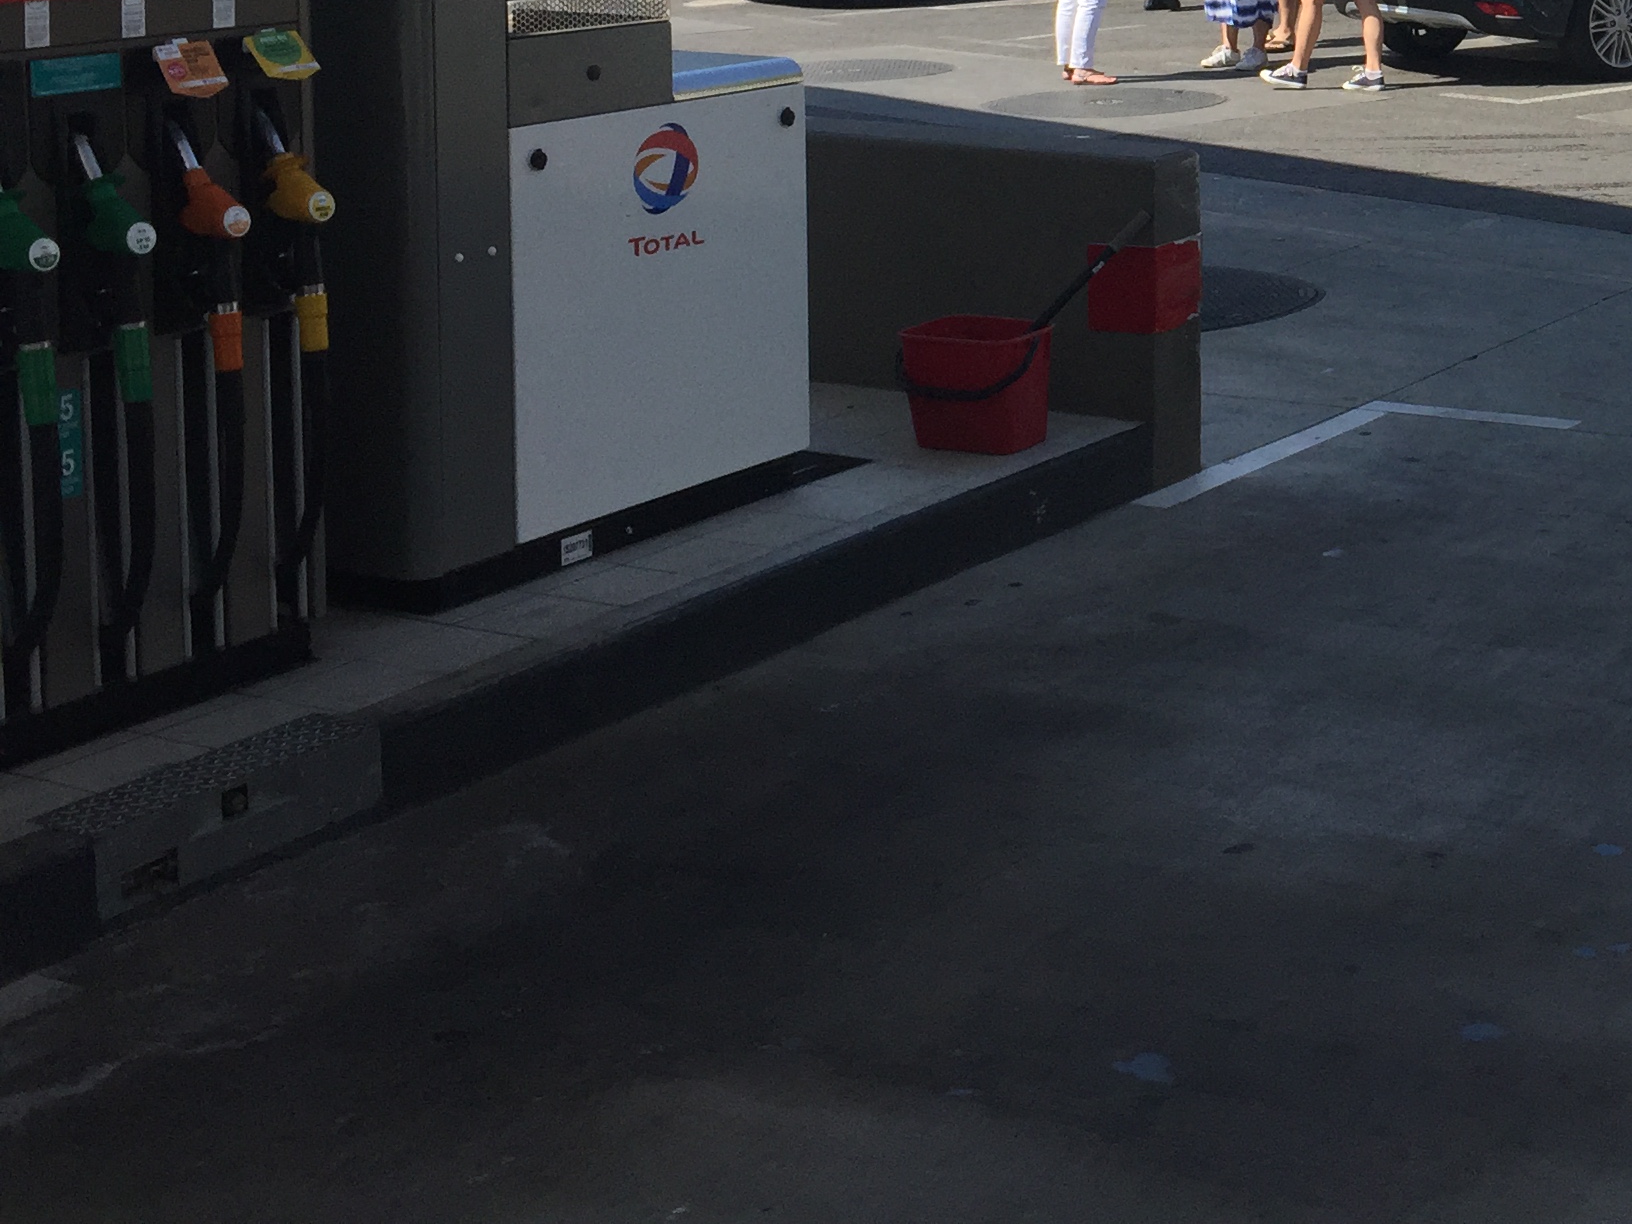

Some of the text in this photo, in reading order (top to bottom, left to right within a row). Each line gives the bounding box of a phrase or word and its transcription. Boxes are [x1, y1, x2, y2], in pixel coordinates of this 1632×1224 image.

[628, 230, 705, 256] TOTAL
[60, 393, 74, 422] 5
[61, 448, 75, 477] 5
